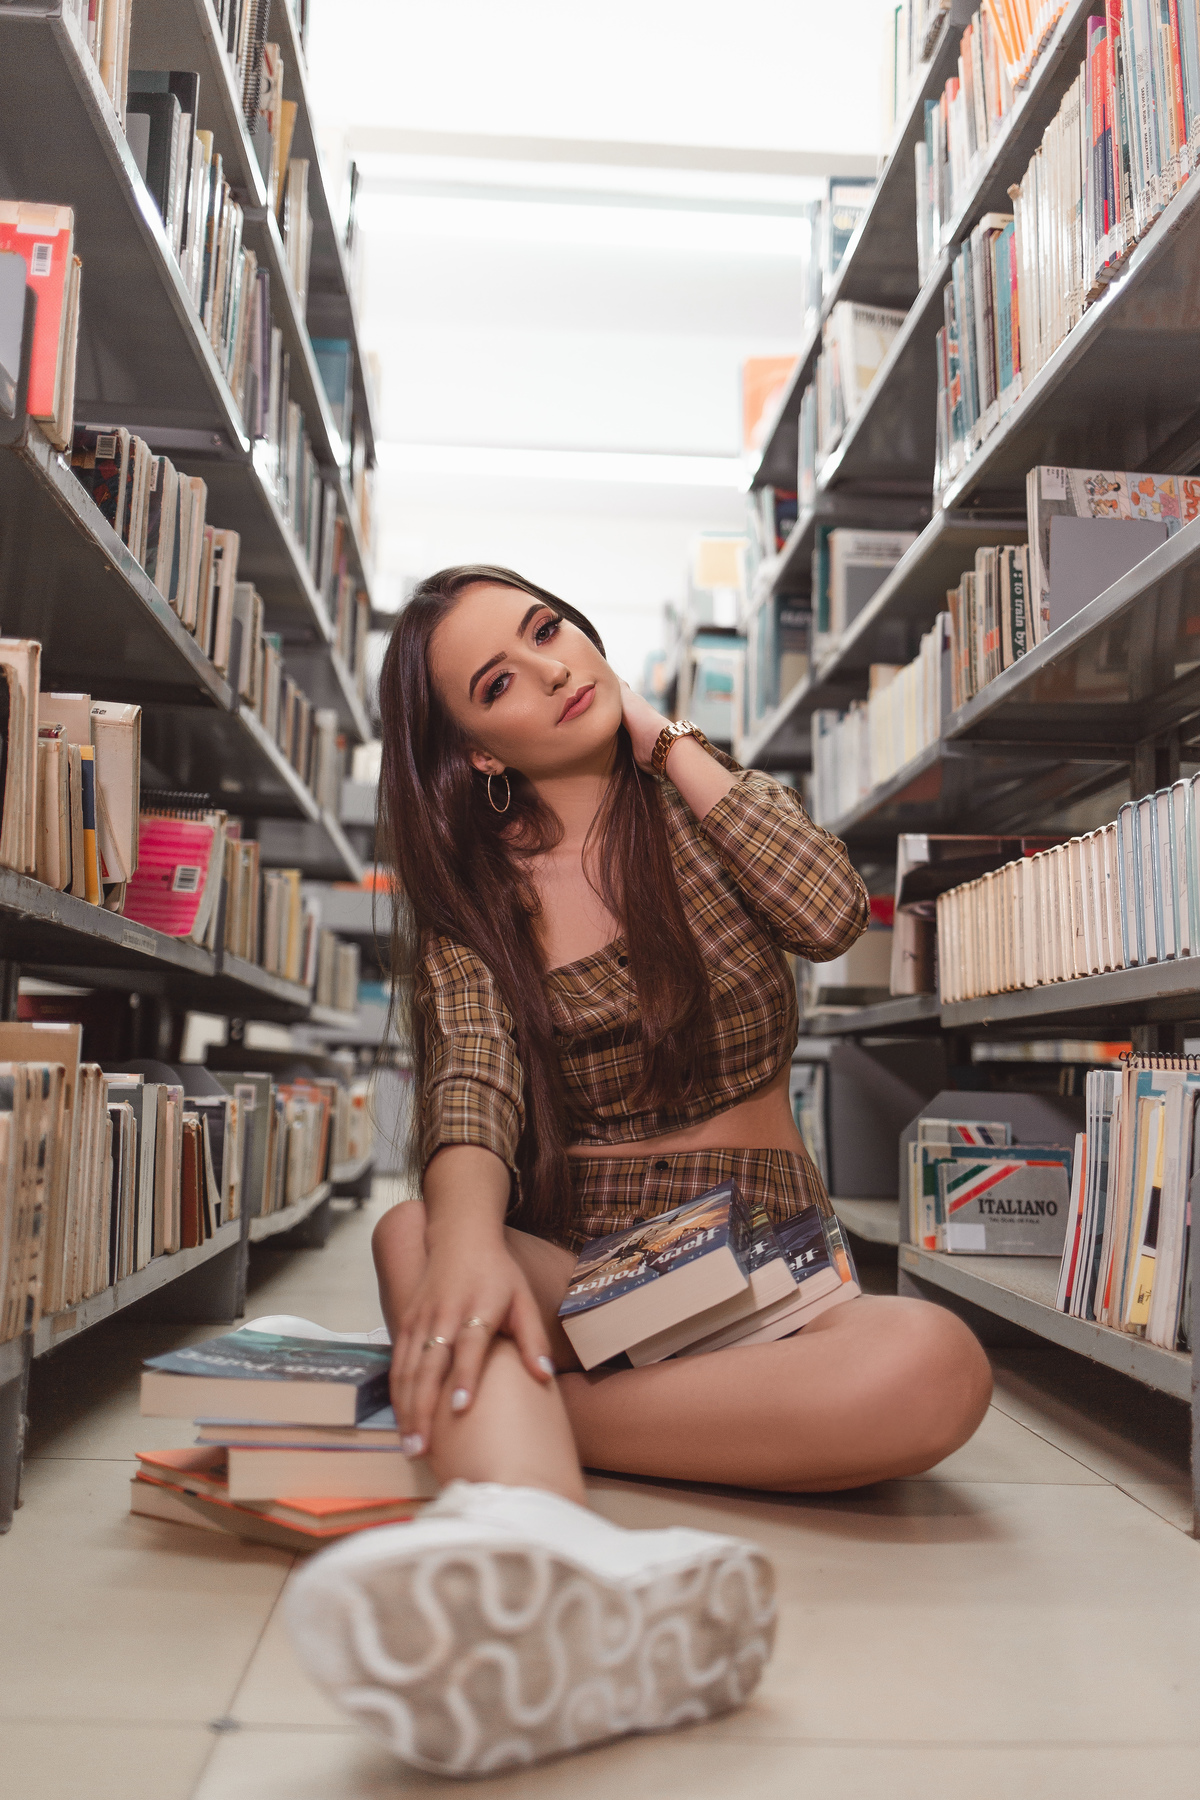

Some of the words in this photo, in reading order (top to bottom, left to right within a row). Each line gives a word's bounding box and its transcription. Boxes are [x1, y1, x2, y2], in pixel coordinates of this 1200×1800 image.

[1014, 582, 1023, 595] to
[1014, 598, 1025, 627] train
[1014, 631, 1026, 647] by
[977, 1198, 1058, 1216] ITALIANO
[649, 1226, 721, 1266] Harry
[568, 1259, 647, 1295] Potter
